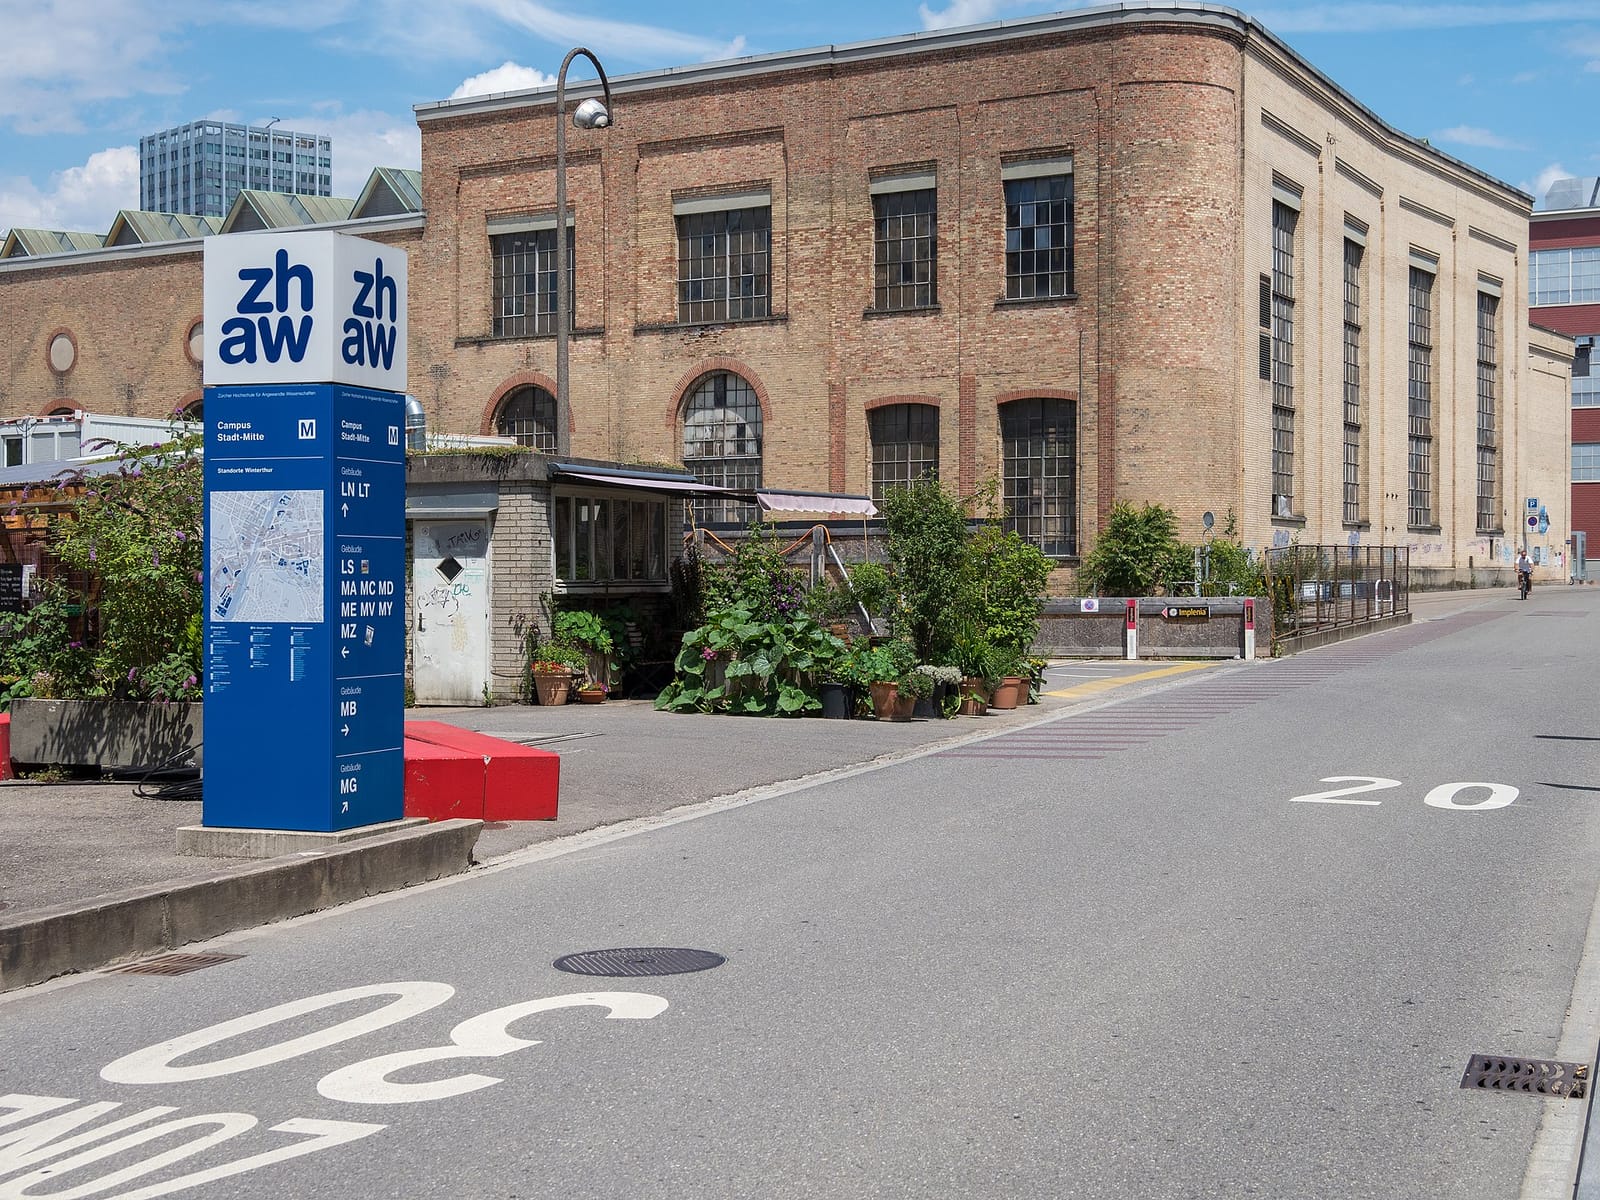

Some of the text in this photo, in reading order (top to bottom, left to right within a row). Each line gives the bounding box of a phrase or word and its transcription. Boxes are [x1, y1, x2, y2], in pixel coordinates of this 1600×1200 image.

[237, 249, 313, 314] zh
[353, 257, 397, 322] zh
[219, 315, 313, 364] aw
[341, 318, 397, 371] aw
[217, 421, 251, 433] Campus
[299, 420, 315, 438] M
[341, 419, 363, 431] Campus
[217, 432, 265, 442] Stadt-Mitte
[341, 431, 370, 443] Stadt-Mitte
[341, 466, 363, 477] Gebäude
[341, 481, 371, 498] LN LT
[341, 544, 363, 554] Gebäude
[341, 559, 355, 575] LS
[341, 580, 394, 596] MA MC MD
[341, 601, 393, 617] ME MV MY
[341, 623, 357, 639] MZ
[341, 686, 362, 696] Gebäude
[341, 700, 357, 717] MB
[341, 763, 362, 773] Gebäude
[341, 777, 357, 795] MG
[1289, 776, 1520, 811] 20
